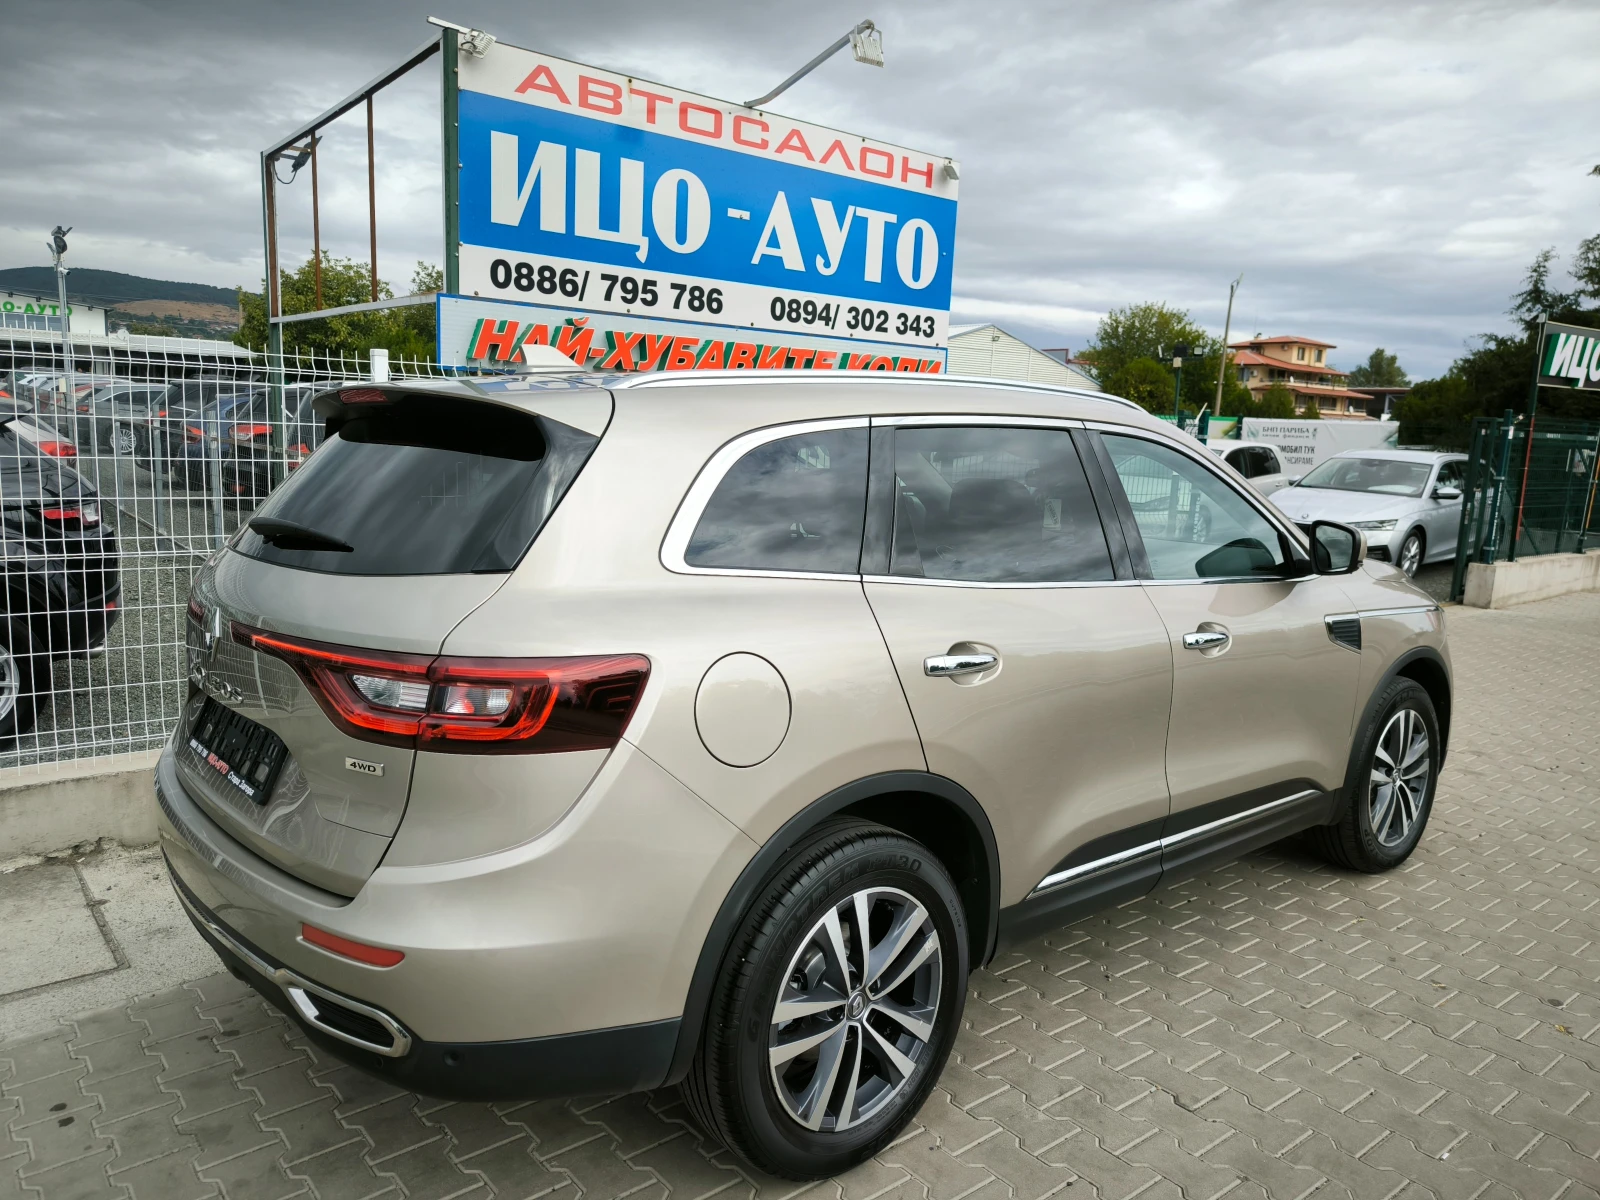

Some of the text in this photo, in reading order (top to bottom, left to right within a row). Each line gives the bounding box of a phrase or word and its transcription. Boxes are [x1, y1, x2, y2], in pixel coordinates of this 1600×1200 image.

[514, 64, 934, 189] АВТОСАЛОН
[489, 258, 723, 314] 0886/ 795 786
[770, 296, 936, 339] 0894/ 302 343
[1284, 456, 1314, 465] НСИРАМЕ
[350, 762, 376, 772] 4WD
